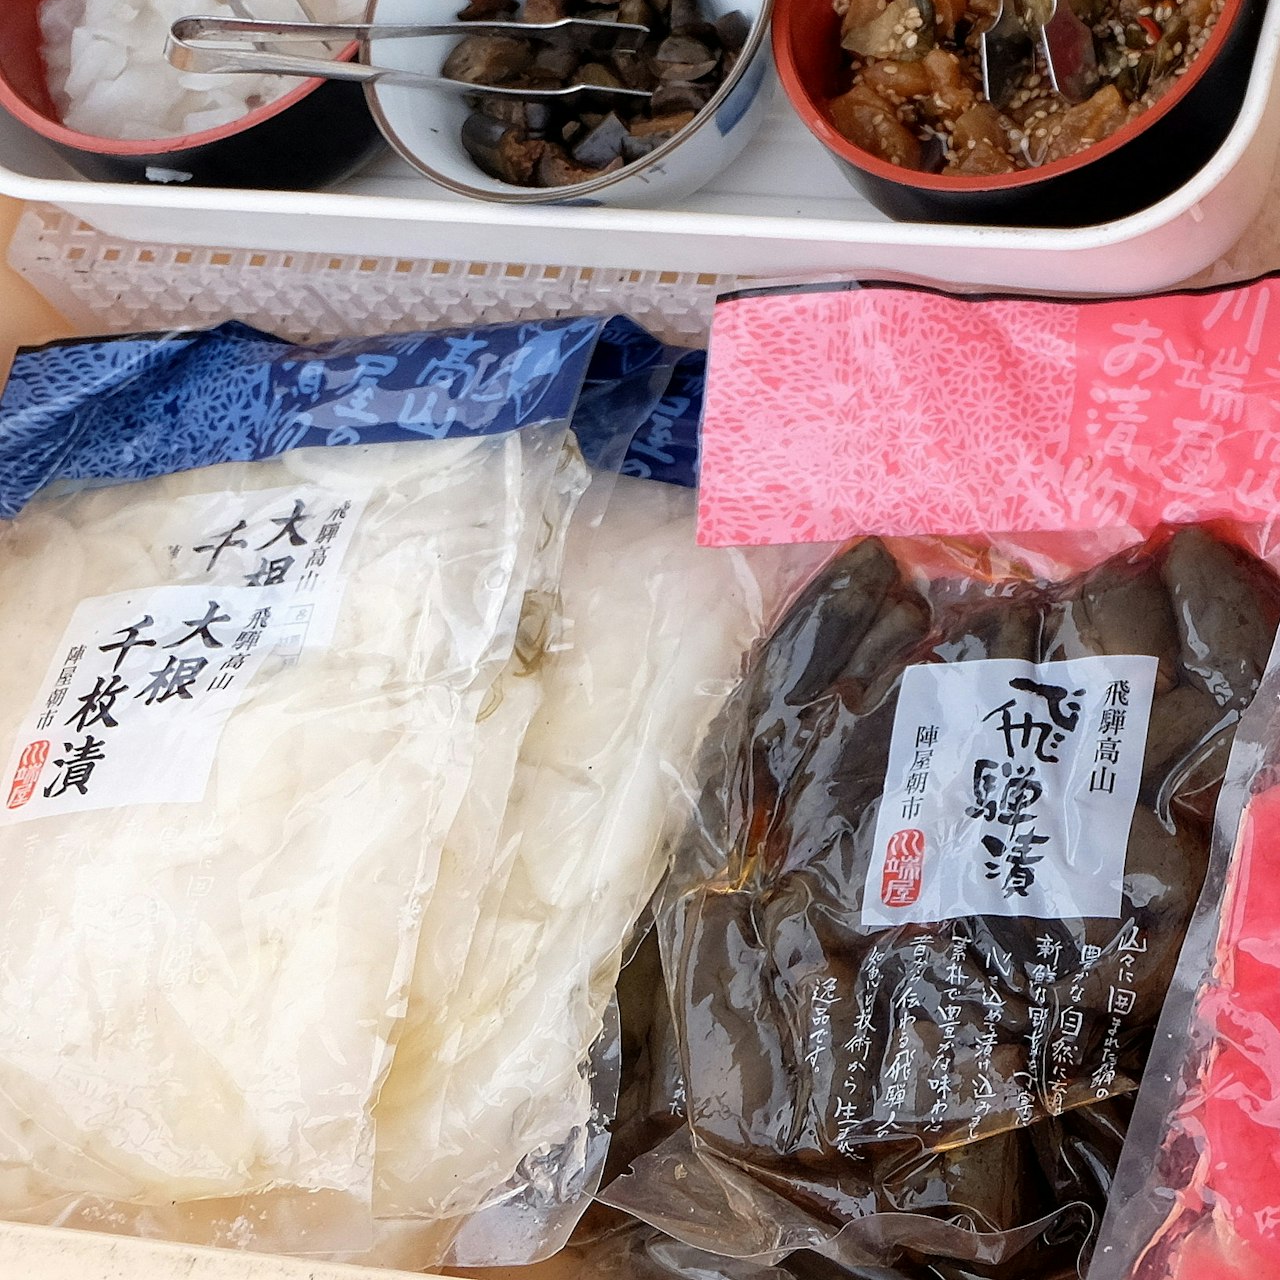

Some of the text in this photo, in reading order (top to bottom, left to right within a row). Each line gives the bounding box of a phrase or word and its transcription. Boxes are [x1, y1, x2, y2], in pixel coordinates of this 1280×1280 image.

[36, 644, 87, 731] 陣屋朝市
[134, 600, 231, 706] 大根
[207, 606, 272, 693] 飛騨高山
[43, 614, 157, 798] 千枚漬
[1088, 679, 1130, 794] 飛騨高山
[901, 724, 940, 821] 陣屋朝市
[965, 677, 1086, 899] 飛騨漬
